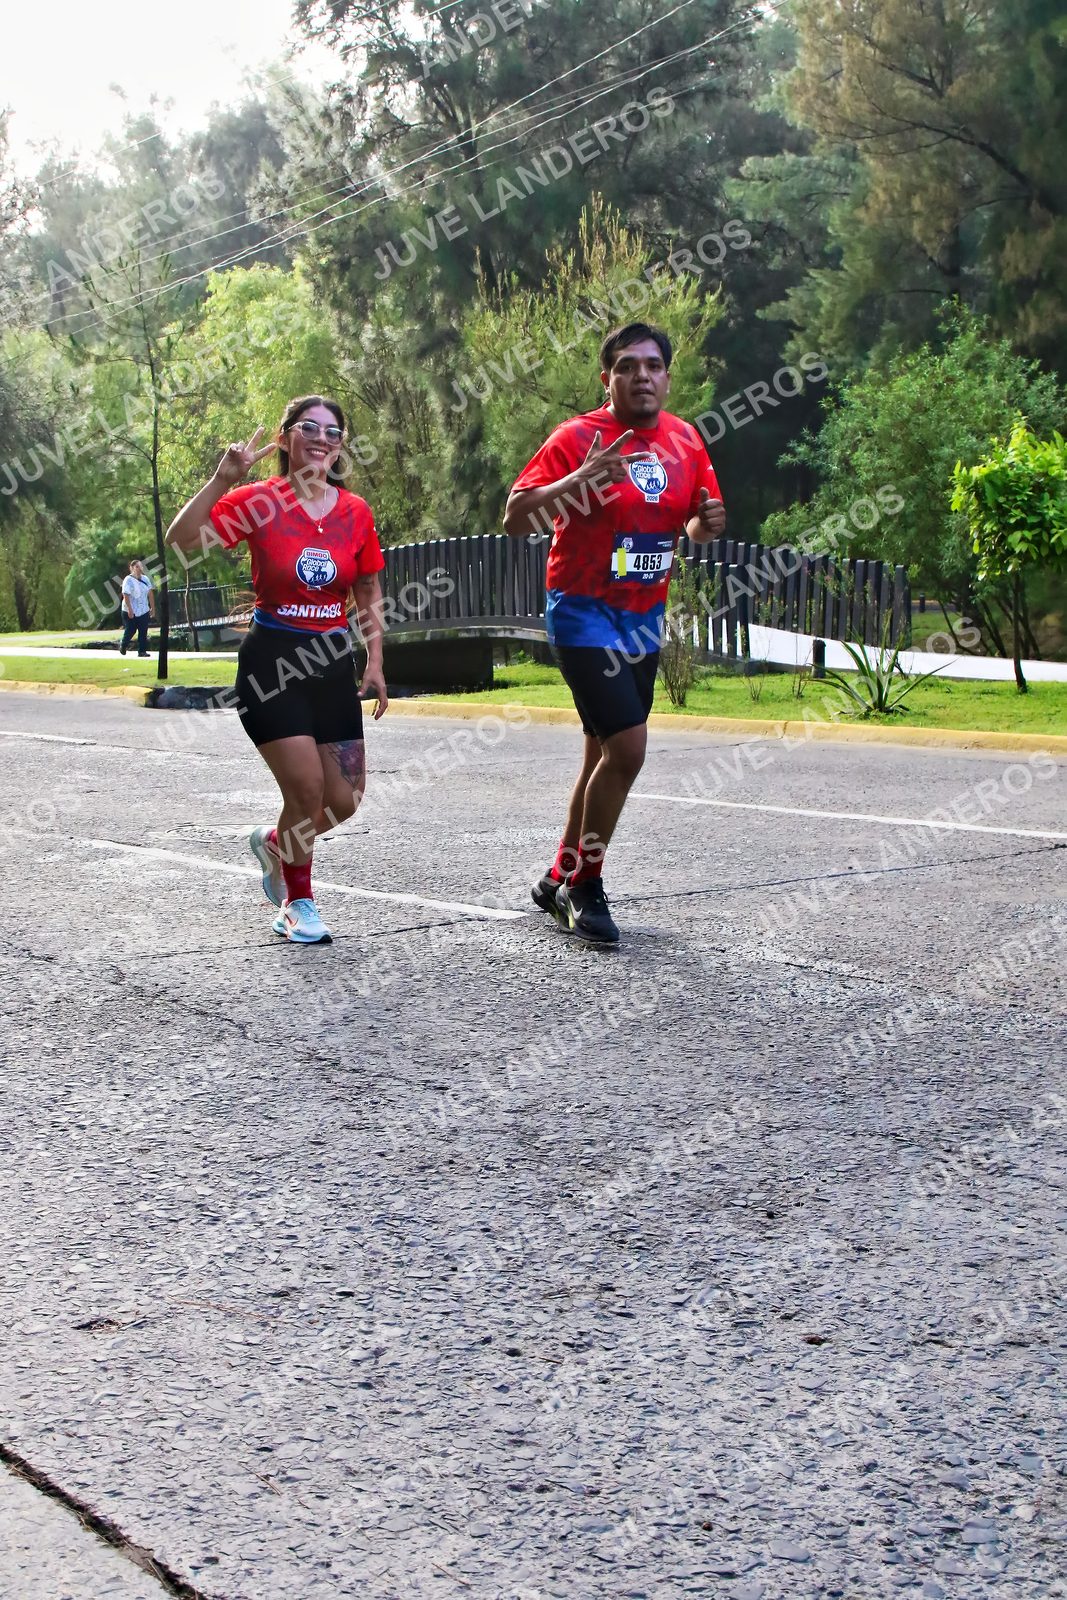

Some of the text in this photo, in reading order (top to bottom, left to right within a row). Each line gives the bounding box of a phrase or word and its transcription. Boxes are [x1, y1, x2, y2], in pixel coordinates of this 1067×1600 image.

[307, 559, 328, 567] Global
[633, 554, 663, 570] 4853
[277, 602, 341, 618] SANTIAGO
